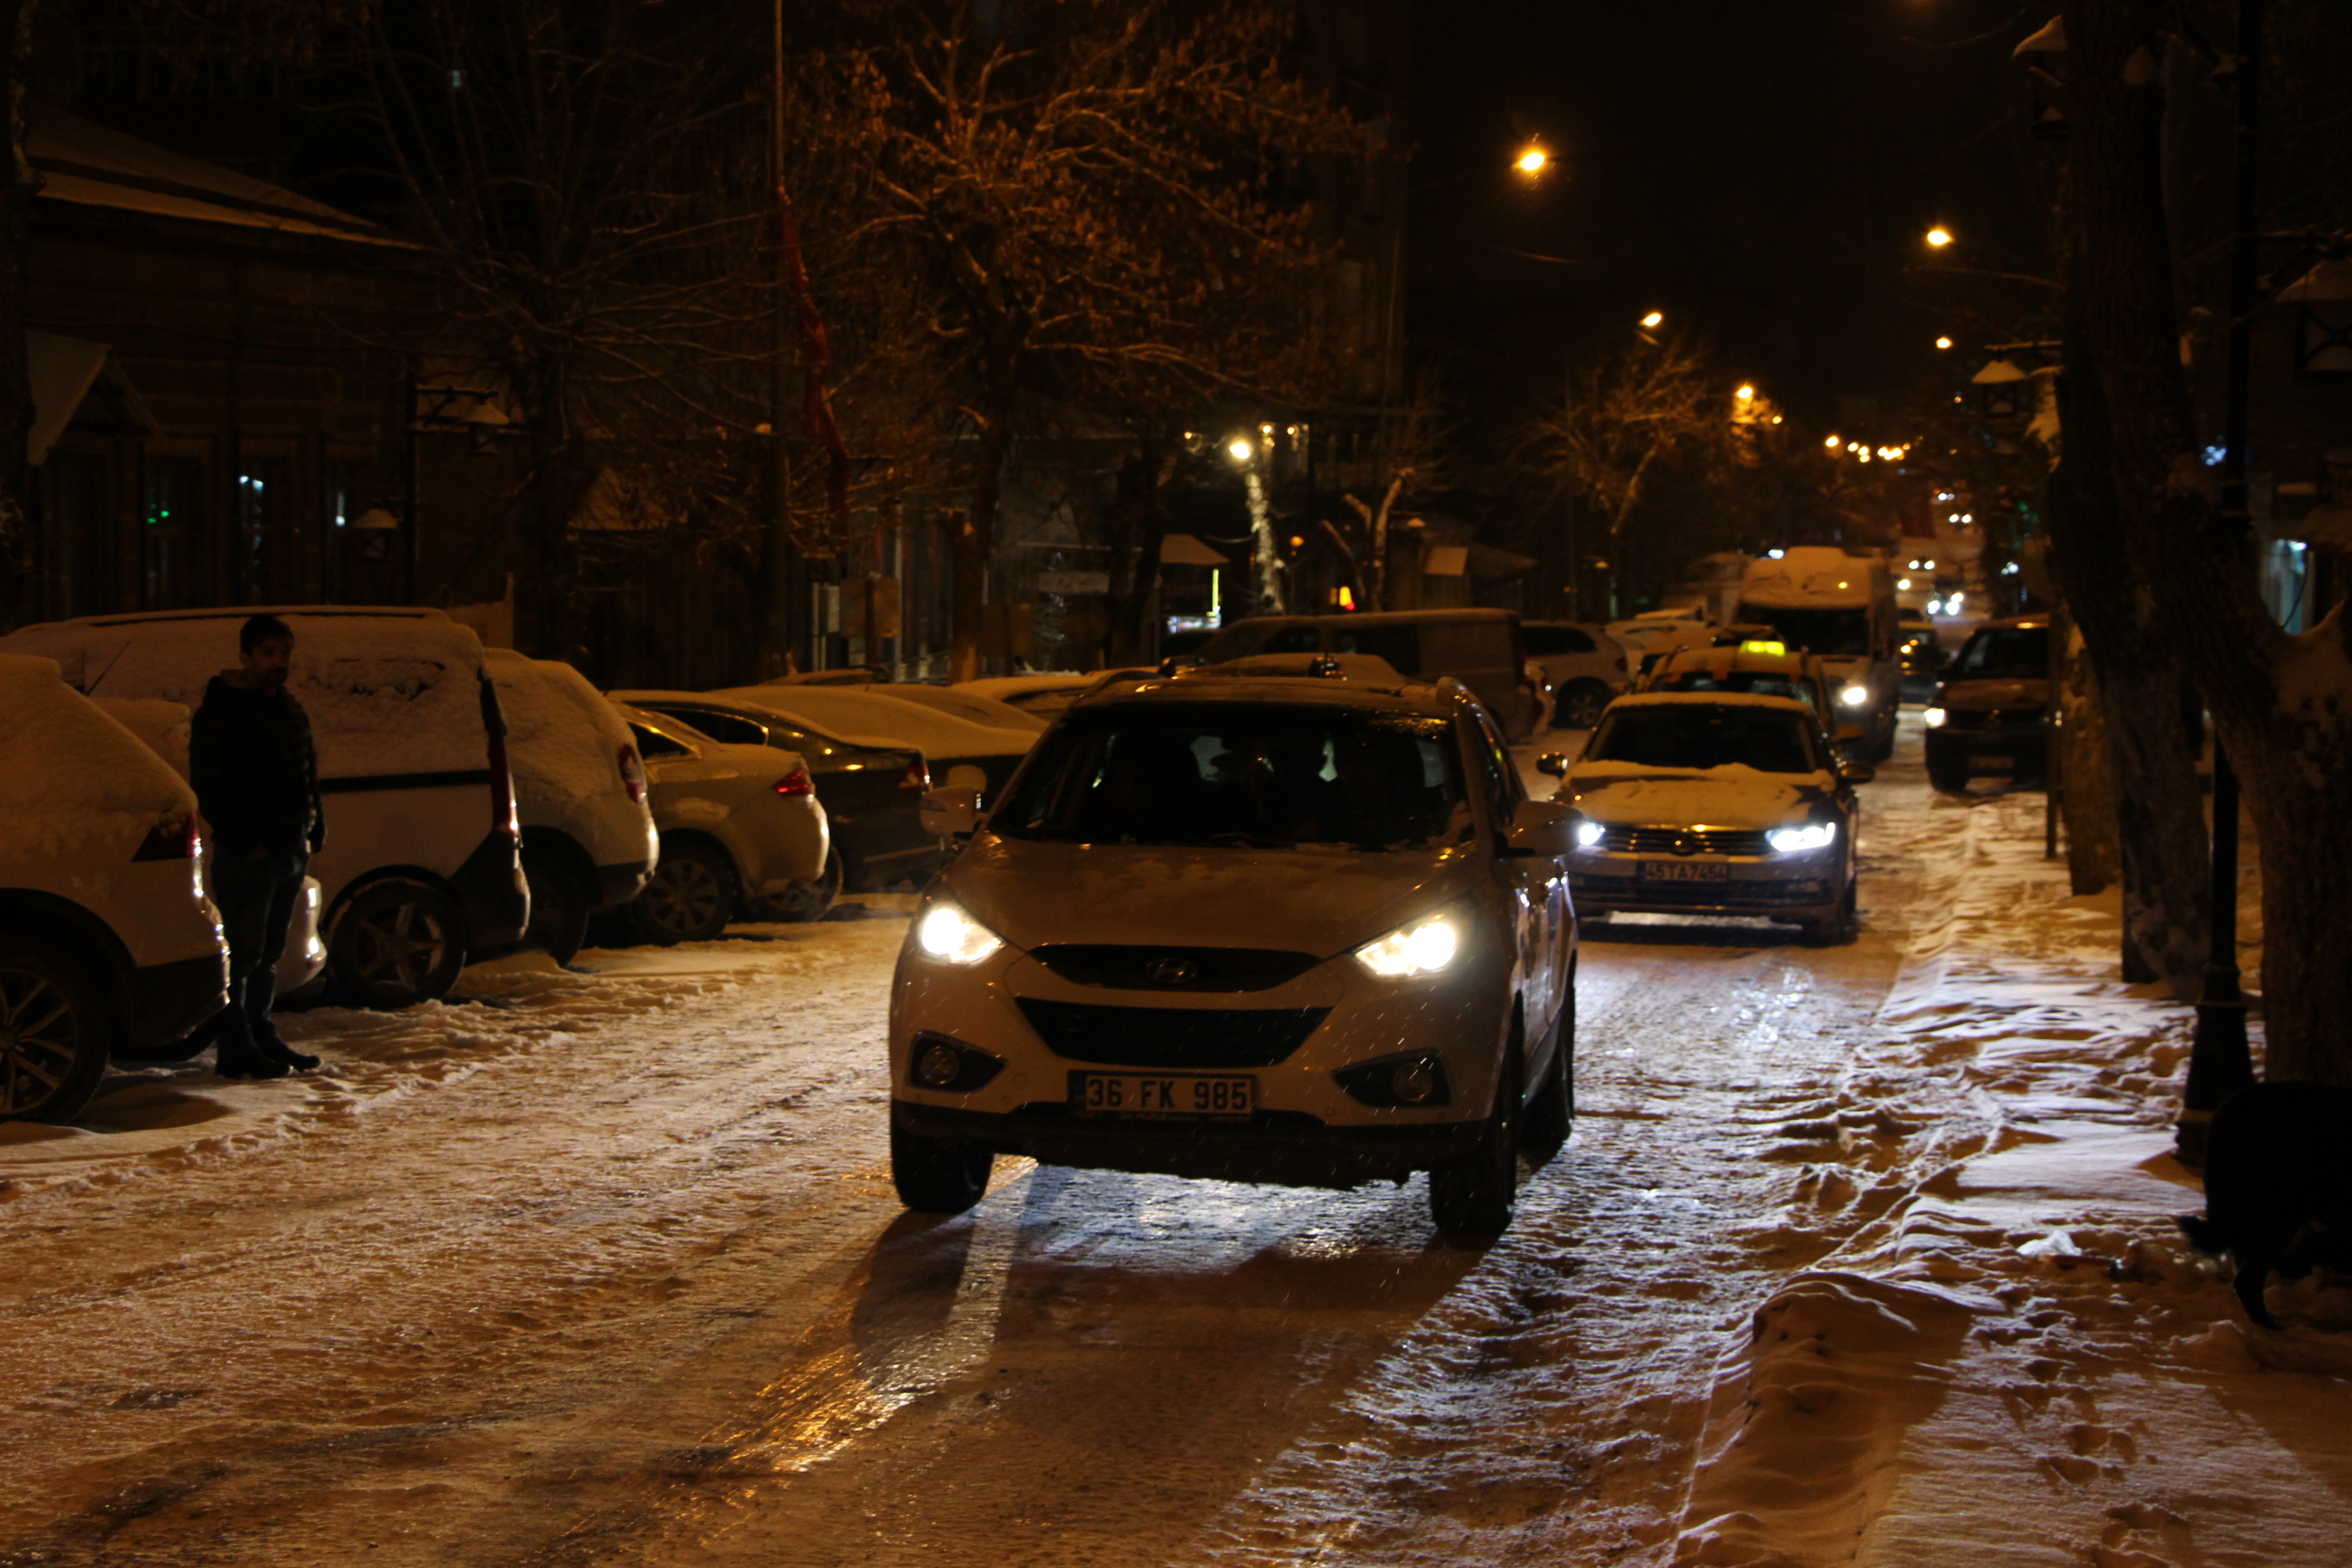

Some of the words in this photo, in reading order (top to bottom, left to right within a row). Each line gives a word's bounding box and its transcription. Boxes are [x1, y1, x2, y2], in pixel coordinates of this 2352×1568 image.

[1089, 1078, 1122, 1107] 36
[1141, 1080, 1174, 1109] FK
[1194, 1081, 1248, 1111] 985
